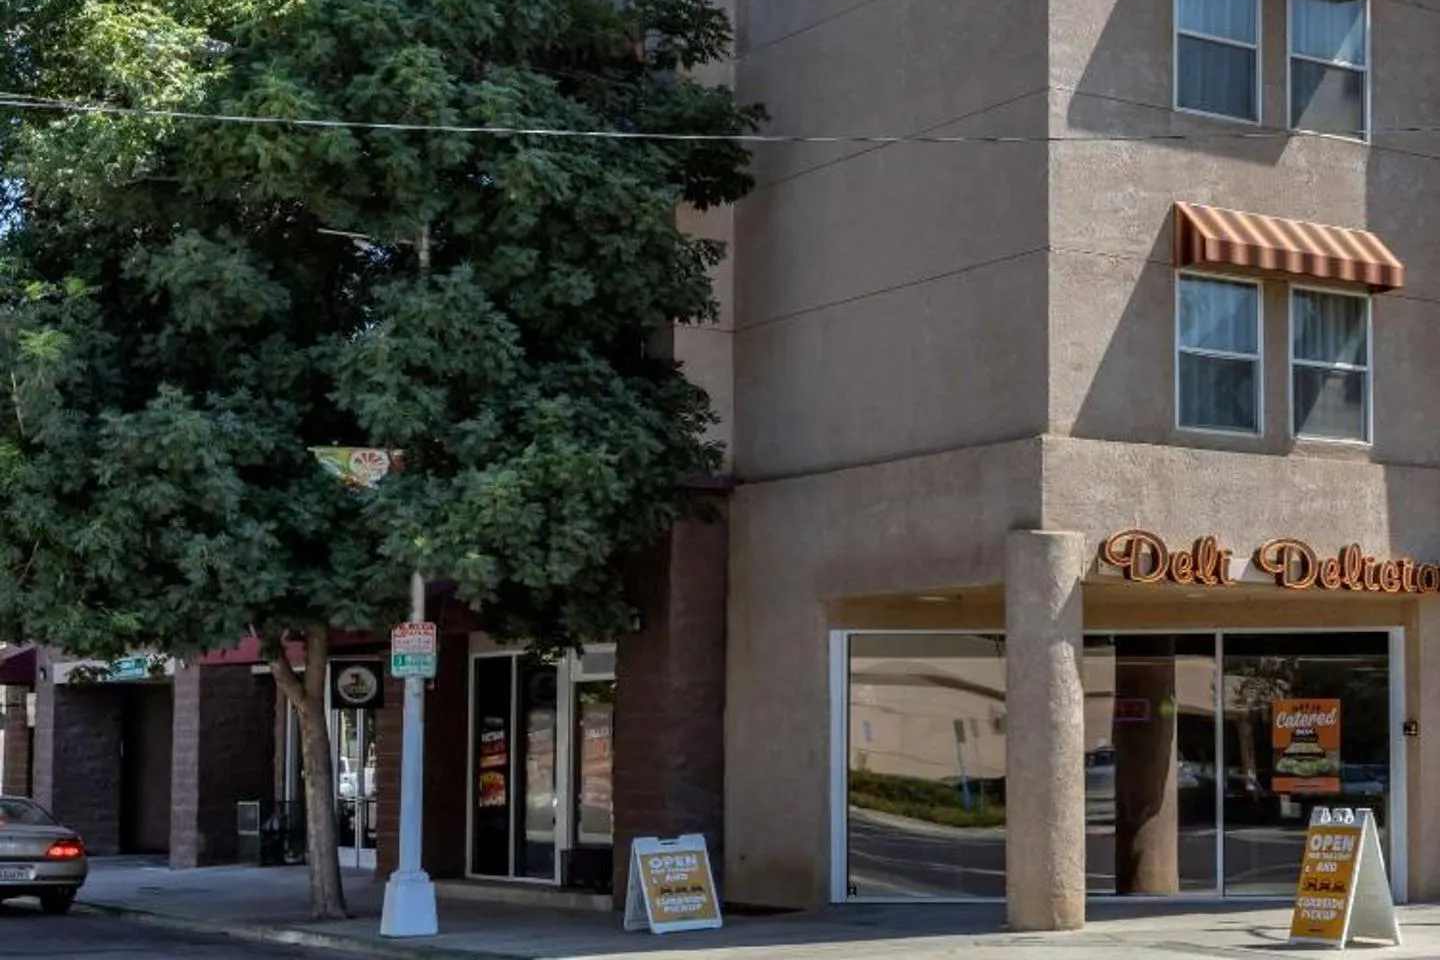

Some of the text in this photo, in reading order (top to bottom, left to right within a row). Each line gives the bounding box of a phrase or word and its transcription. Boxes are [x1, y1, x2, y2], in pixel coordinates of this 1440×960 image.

[1104, 528, 1236, 585] Deli
[1276, 708, 1336, 729] Catered
[1310, 835, 1353, 852] OPEN
[650, 854, 698, 870] OPEN
